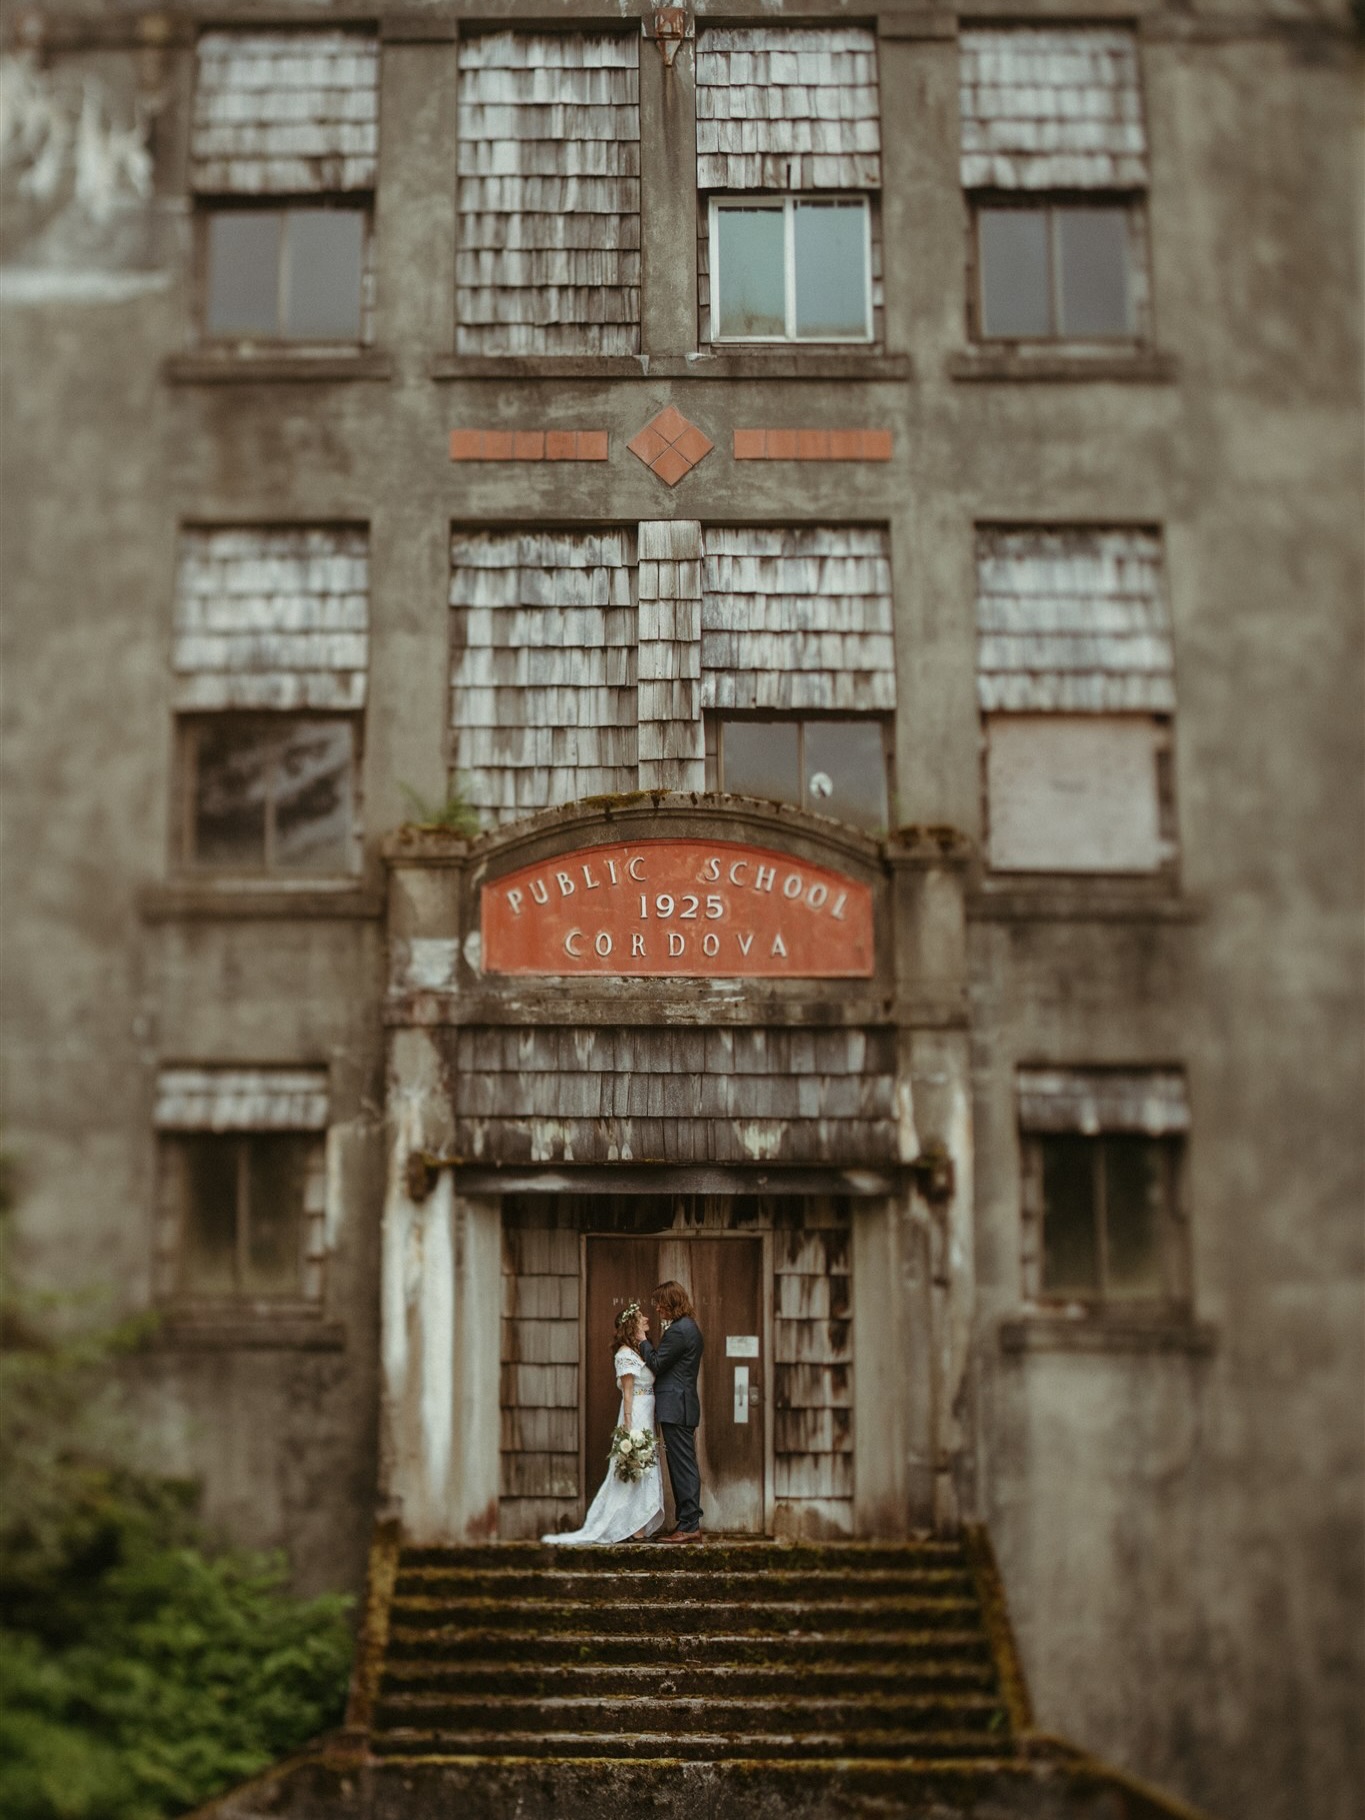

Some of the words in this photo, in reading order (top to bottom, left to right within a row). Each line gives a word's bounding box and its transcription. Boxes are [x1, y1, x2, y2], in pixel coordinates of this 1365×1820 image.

[506, 857, 648, 915] PUBLIC
[704, 857, 849, 920] SCHOOL
[639, 894, 725, 919] 1925
[564, 931, 788, 958] CORDOVA
